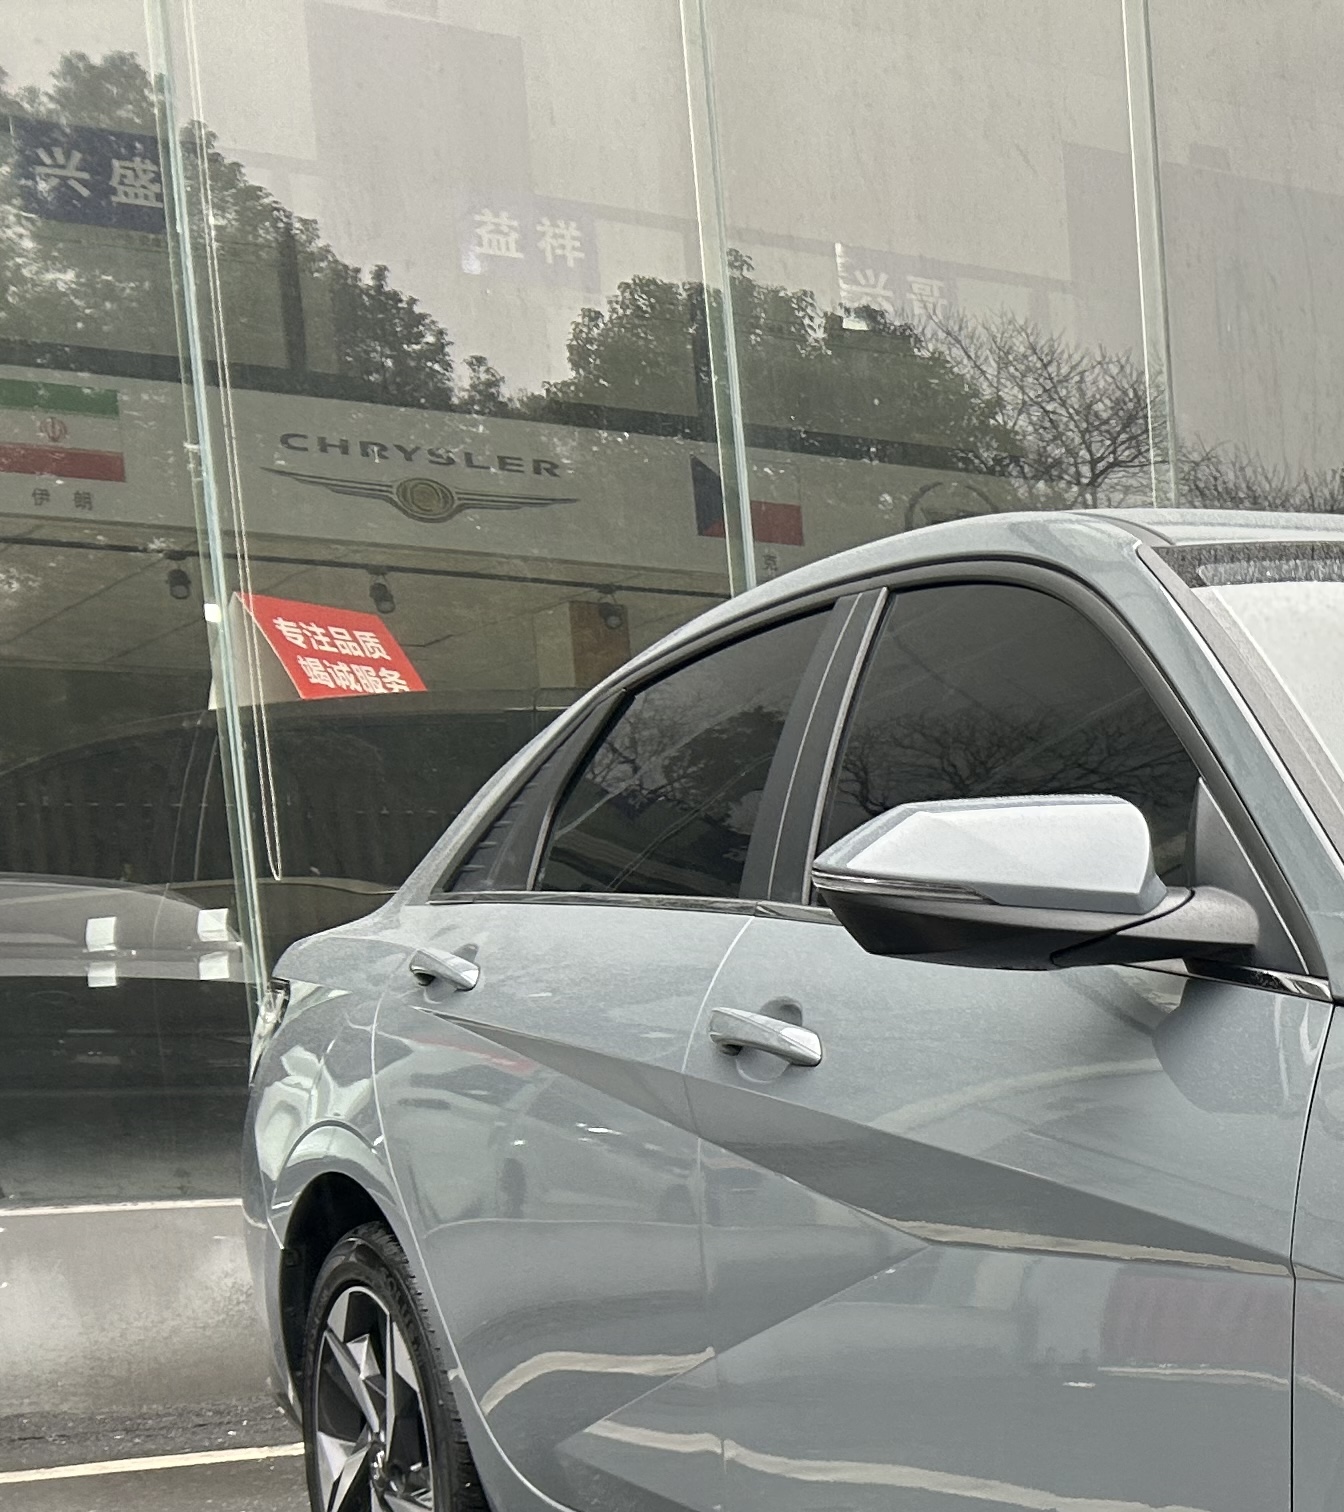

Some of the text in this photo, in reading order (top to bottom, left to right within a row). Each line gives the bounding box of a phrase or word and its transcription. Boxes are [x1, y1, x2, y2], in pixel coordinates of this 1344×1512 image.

[279, 432, 562, 478] CHRYSLER
[31, 487, 94, 512] 伊朗
[272, 616, 392, 662] 专注品质
[297, 655, 411, 694] 竭诚服务
